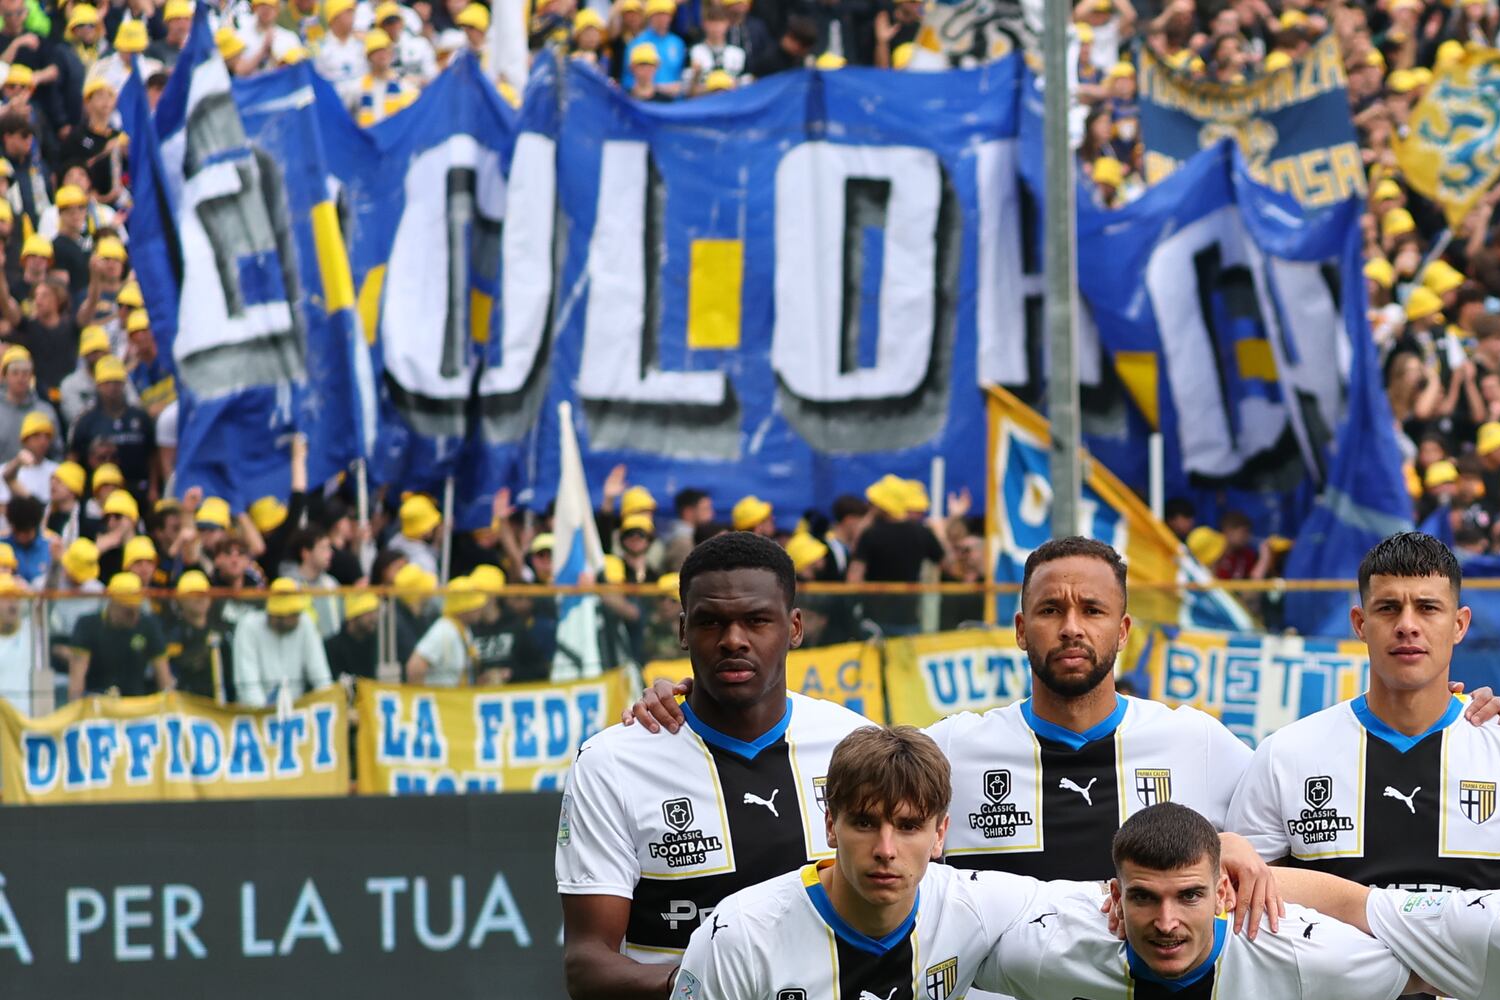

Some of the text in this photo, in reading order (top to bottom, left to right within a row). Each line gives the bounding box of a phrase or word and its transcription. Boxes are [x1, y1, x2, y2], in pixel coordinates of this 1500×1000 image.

[378, 695, 445, 761] LA
[23, 705, 336, 791] DIFFIDATI
[982, 804, 1015, 814] CLASSIC
[1301, 809, 1337, 819] CLASSIC
[970, 812, 1032, 829] FOOTBALL
[1289, 817, 1353, 833] FOOTBALL
[664, 831, 702, 843] CLASSIC
[984, 826, 1016, 838] SHIRTS
[1304, 831, 1336, 843] SHIRTS
[650, 838, 721, 857] FOOTBALL
[668, 853, 705, 866] SHIRTS
[66, 885, 208, 963] PER
[242, 880, 341, 957] LA
[367, 873, 532, 952] TUA
